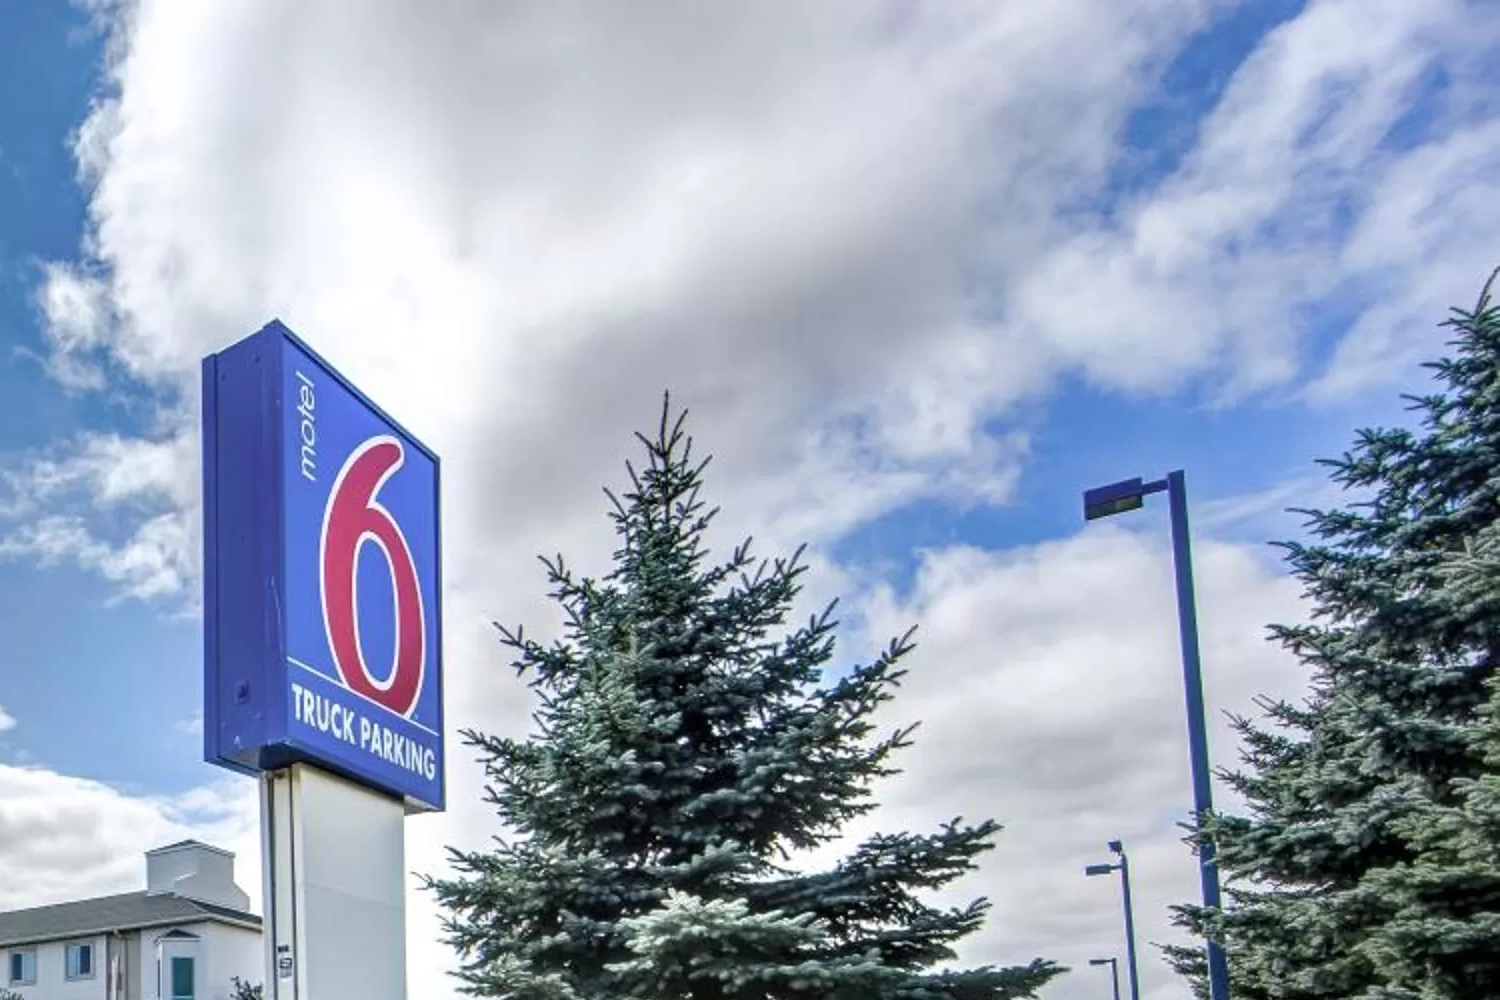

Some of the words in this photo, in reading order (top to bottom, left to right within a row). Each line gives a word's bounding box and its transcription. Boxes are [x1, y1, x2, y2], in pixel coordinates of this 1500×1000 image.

[295, 370, 316, 481] motel
[319, 434, 426, 719] 6
[291, 683, 357, 745] TRUCK
[360, 717, 436, 781] PARKING
